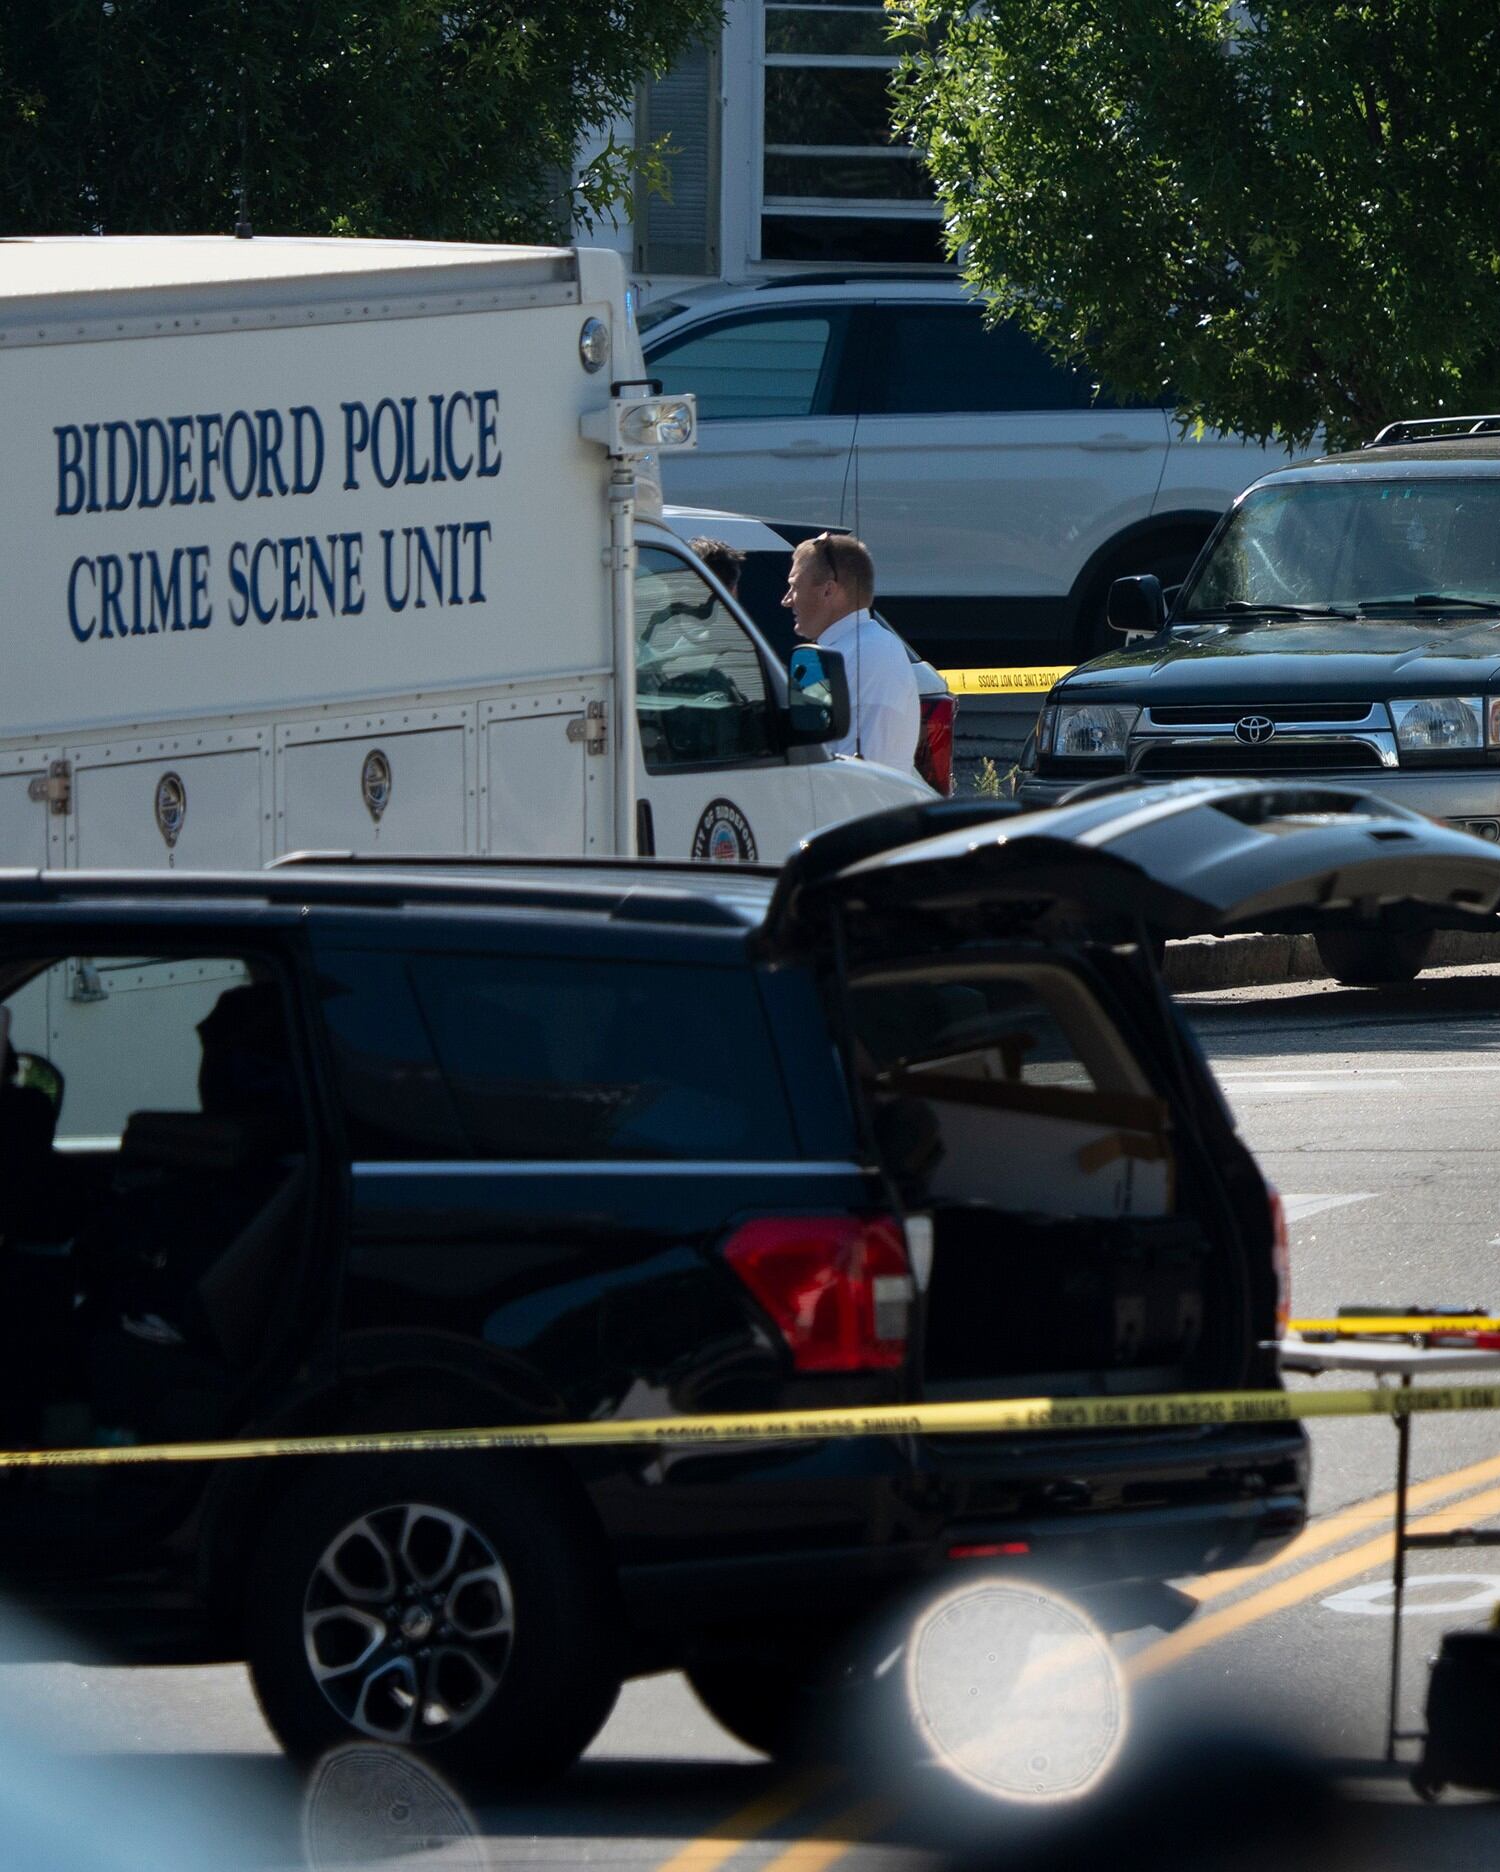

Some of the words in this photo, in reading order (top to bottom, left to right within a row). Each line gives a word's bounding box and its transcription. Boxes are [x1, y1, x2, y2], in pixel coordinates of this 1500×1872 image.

[53, 404, 324, 516] BIDDEFORD
[341, 389, 502, 490] POLICE
[67, 545, 212, 643] CRIME
[228, 532, 364, 627] SCENE
[380, 520, 492, 613] UNIT
[978, 675, 999, 688] CROSS
[1000, 674, 1012, 688] NOT
[1014, 674, 1024, 687] DO
[1024, 673, 1038, 687] LINE
